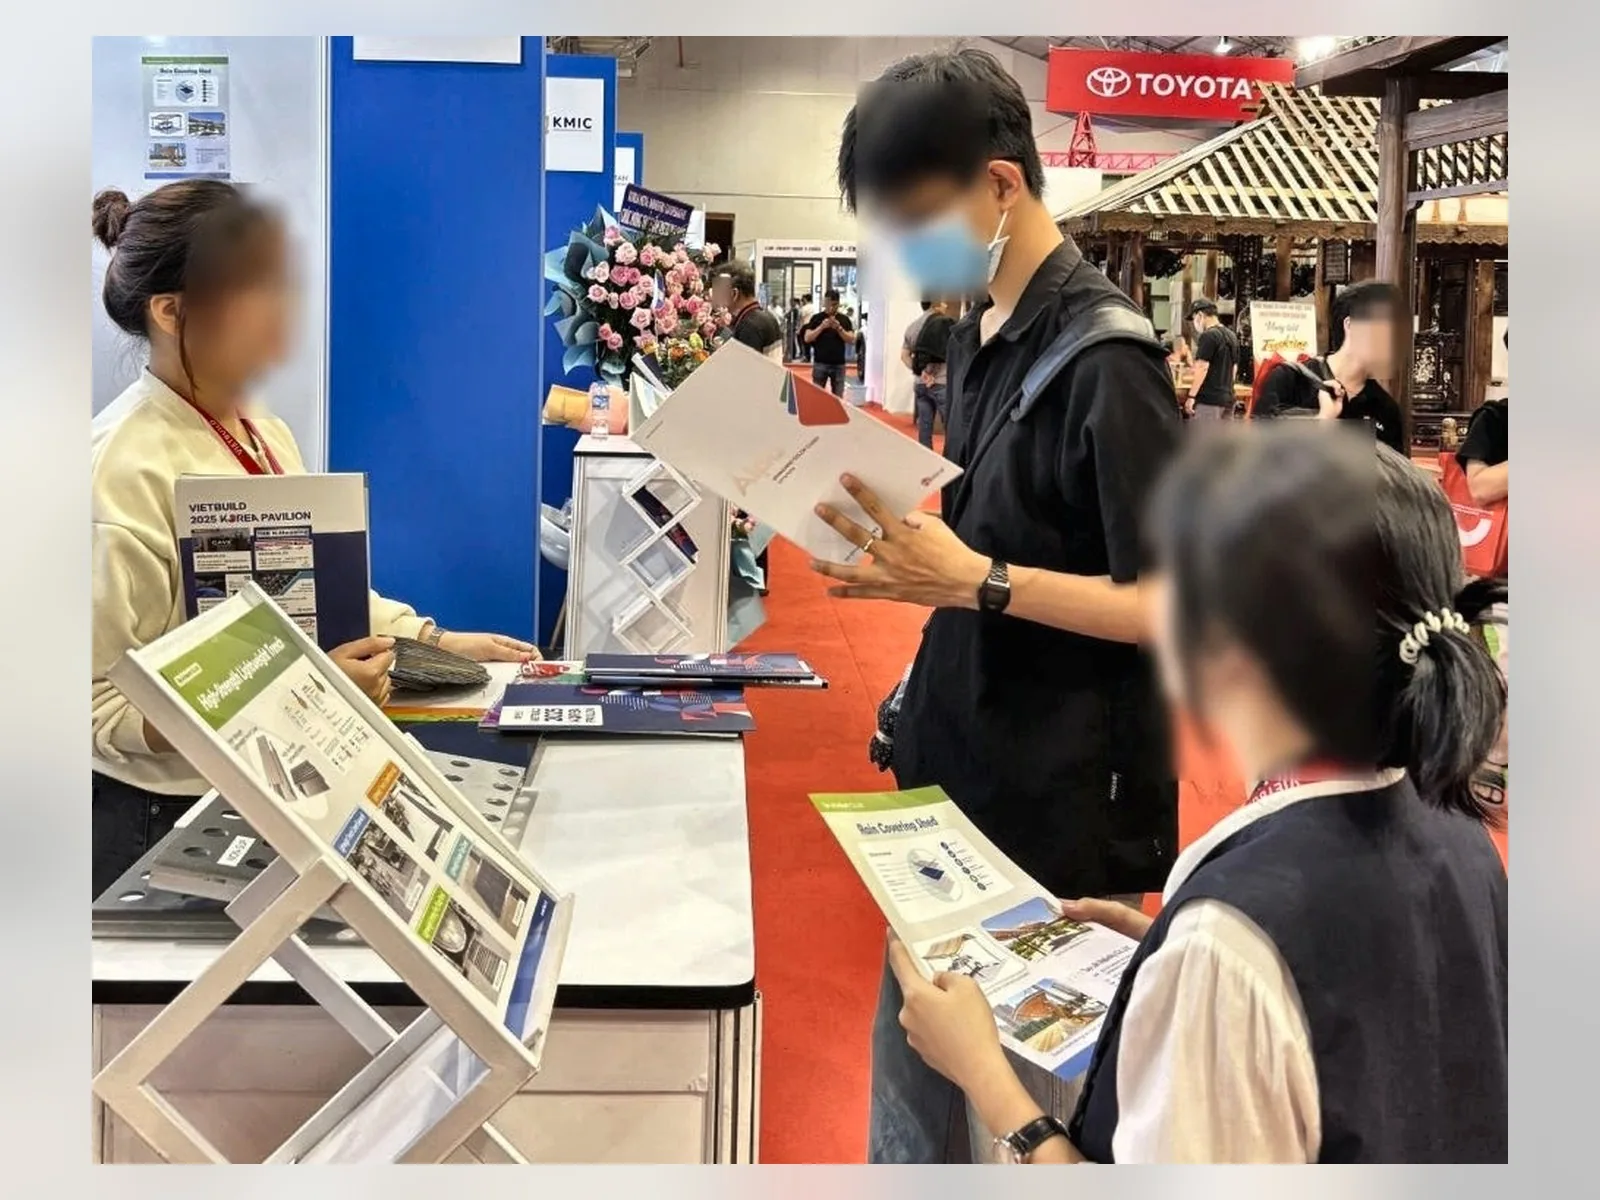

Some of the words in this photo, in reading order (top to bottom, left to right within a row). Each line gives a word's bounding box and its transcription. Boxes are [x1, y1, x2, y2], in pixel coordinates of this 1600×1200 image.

[1135, 73, 1252, 100] TOYOTA
[552, 115, 593, 130] KMIC
[189, 502, 247, 513] VIETBUILD
[190, 515, 217, 524] 2025
[261, 511, 311, 522] PAVILION
[856, 822, 880, 835] Rain
[878, 820, 918, 834] Covering
[914, 815, 939, 829] Shed
